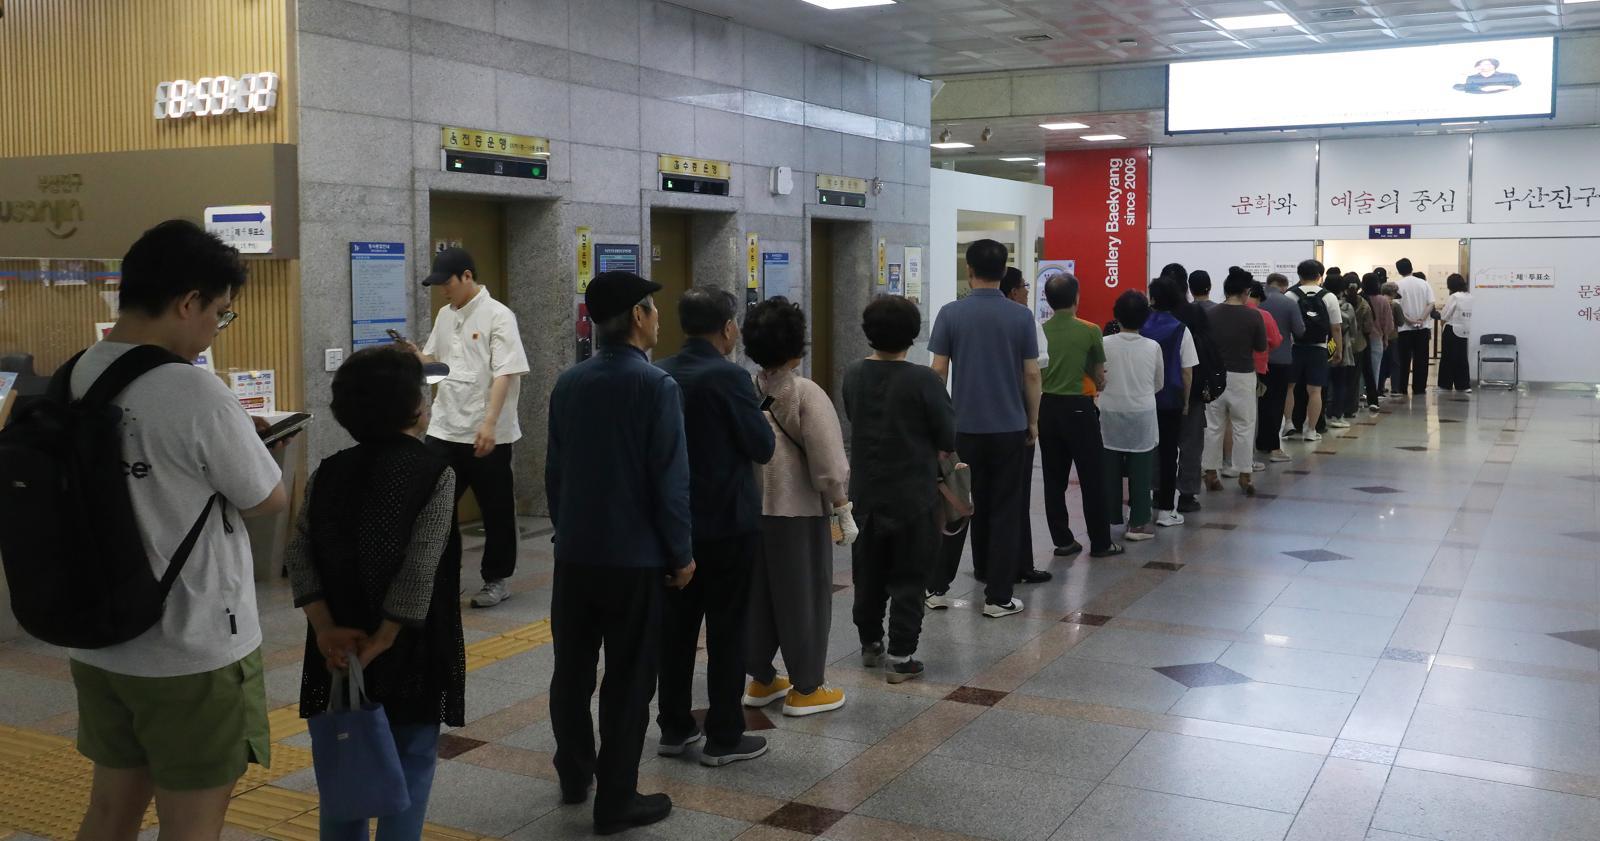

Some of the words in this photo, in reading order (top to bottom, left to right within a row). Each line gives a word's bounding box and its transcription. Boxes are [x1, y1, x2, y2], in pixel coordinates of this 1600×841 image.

[1124, 158, 1136, 189] 2006
[1106, 158, 1123, 232] Baekyang
[1124, 192, 1136, 226] since
[1231, 193, 1297, 216] 문화와
[1330, 189, 1399, 215] 예술의
[1409, 189, 1455, 213] 중심
[1494, 185, 1600, 211] 부산진구
[1105, 236, 1121, 288] Gallery
